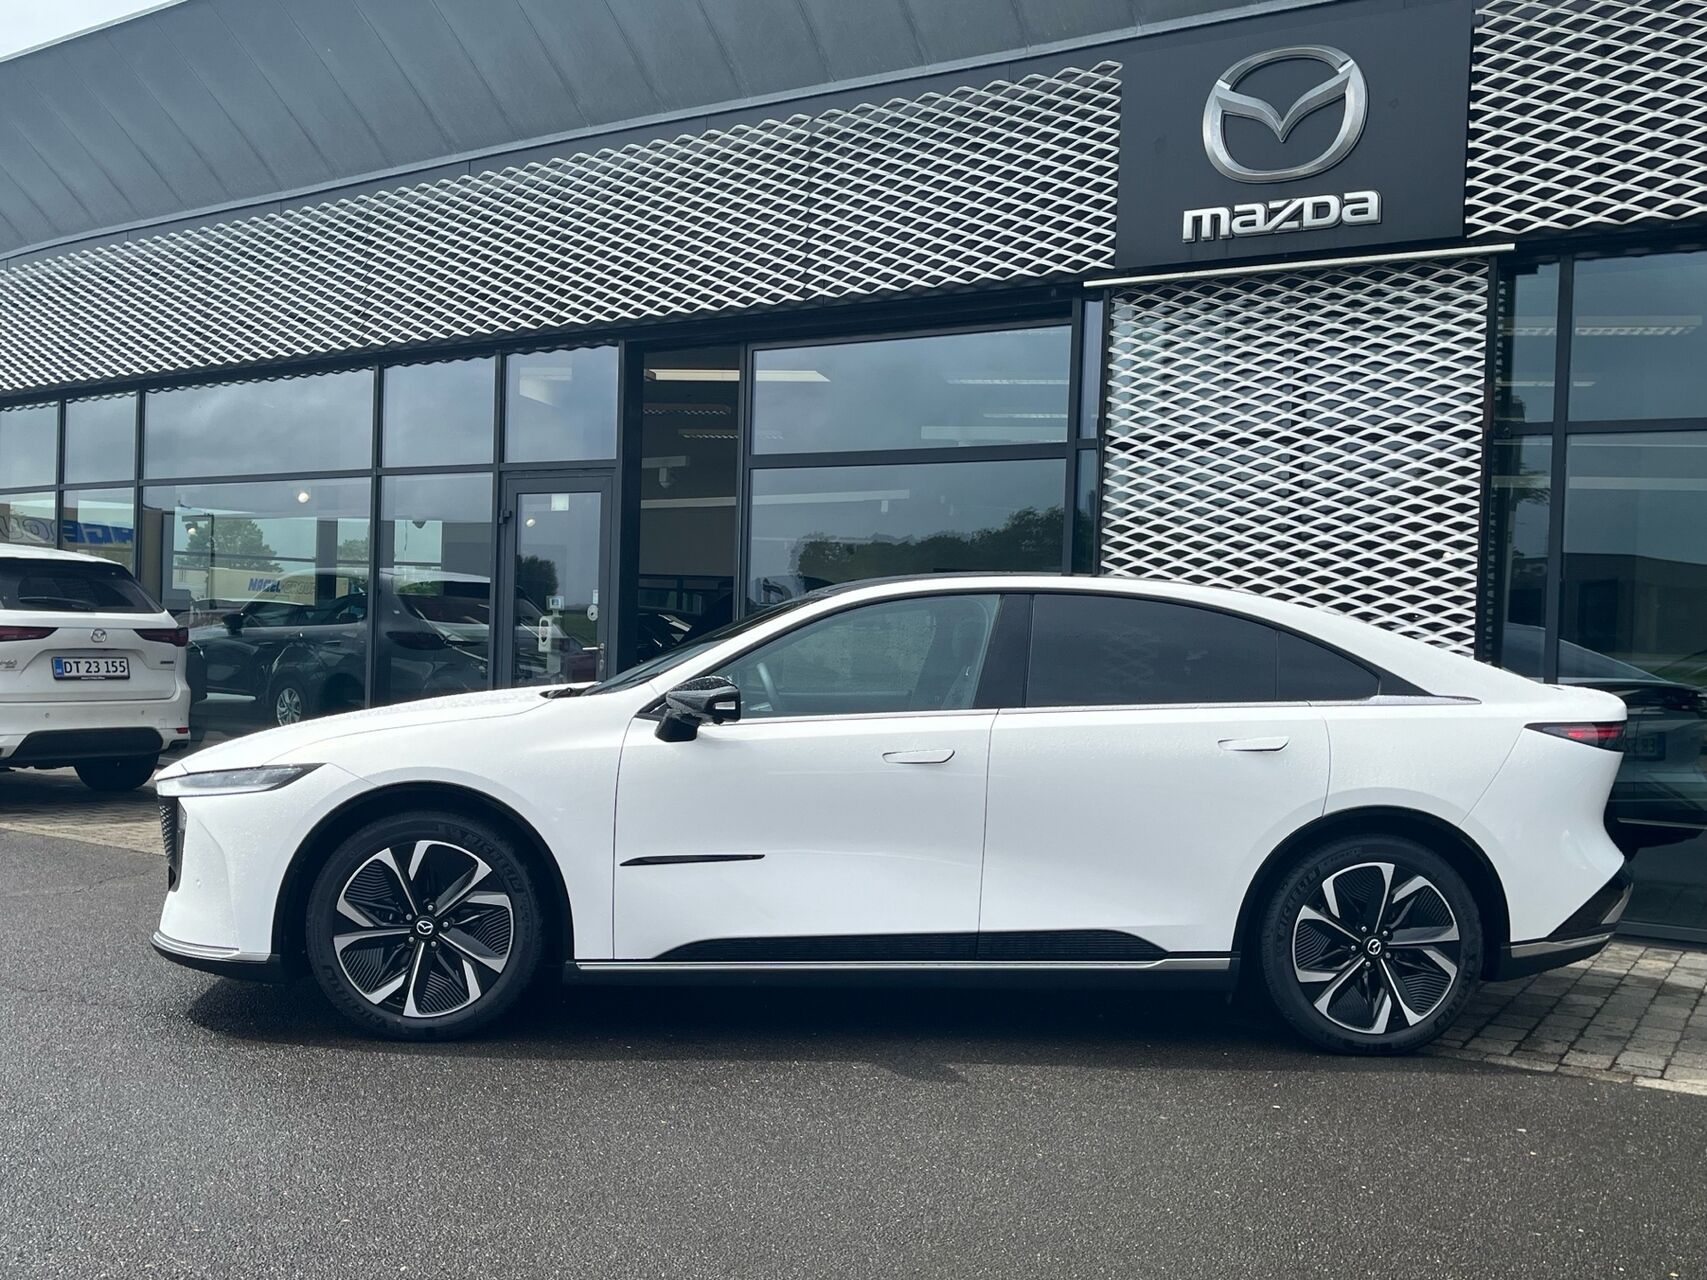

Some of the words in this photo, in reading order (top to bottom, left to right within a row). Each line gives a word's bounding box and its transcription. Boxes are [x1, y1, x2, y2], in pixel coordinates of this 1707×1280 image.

[64, 660, 81, 674] DT
[85, 660, 100, 674] 23
[104, 660, 126, 674] 155
[463, 832, 526, 893] MICHELIN
[1276, 866, 1321, 941] MICHELIN
